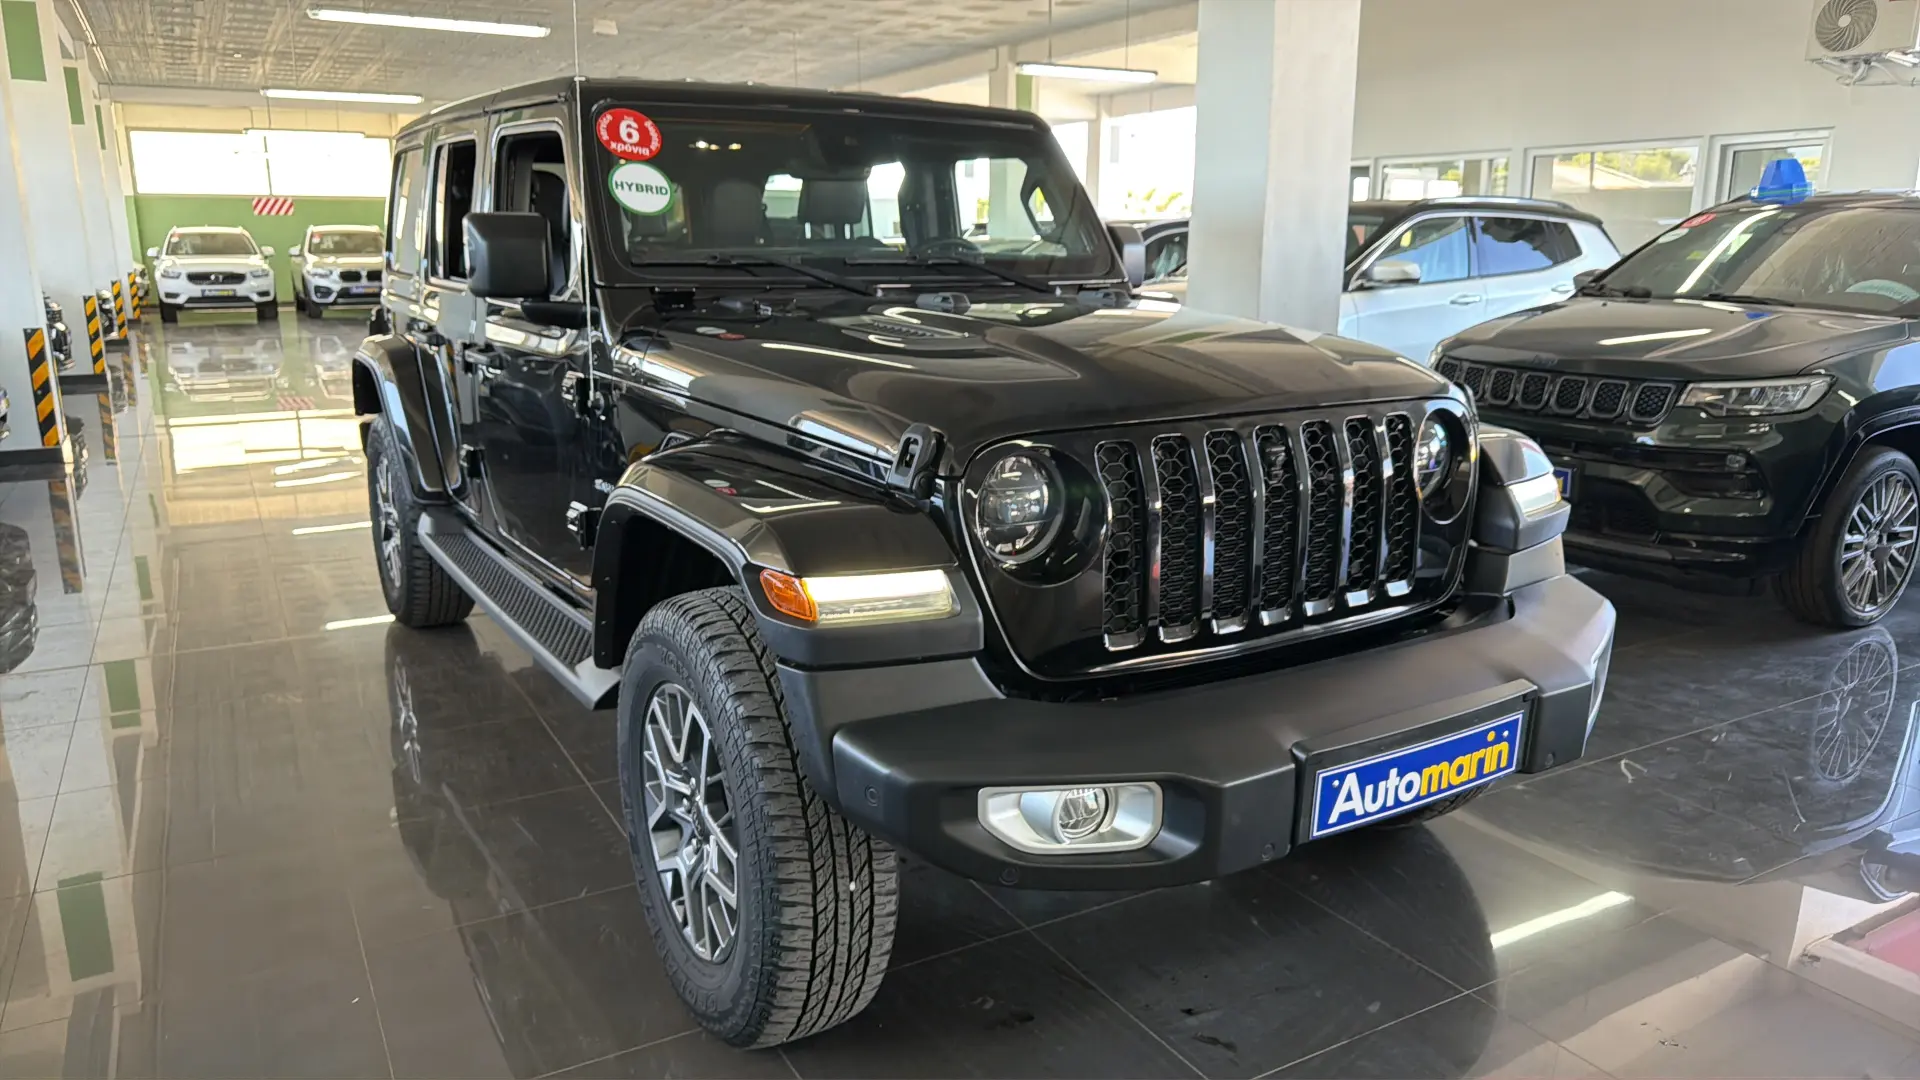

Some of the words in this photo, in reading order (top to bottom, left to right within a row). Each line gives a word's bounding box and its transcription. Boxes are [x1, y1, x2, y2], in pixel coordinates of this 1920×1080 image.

[619, 119, 640, 144] 6
[610, 142, 650, 156] χρόνια
[614, 180, 669, 196] HYBRID
[1328, 731, 1510, 825] Automarin
